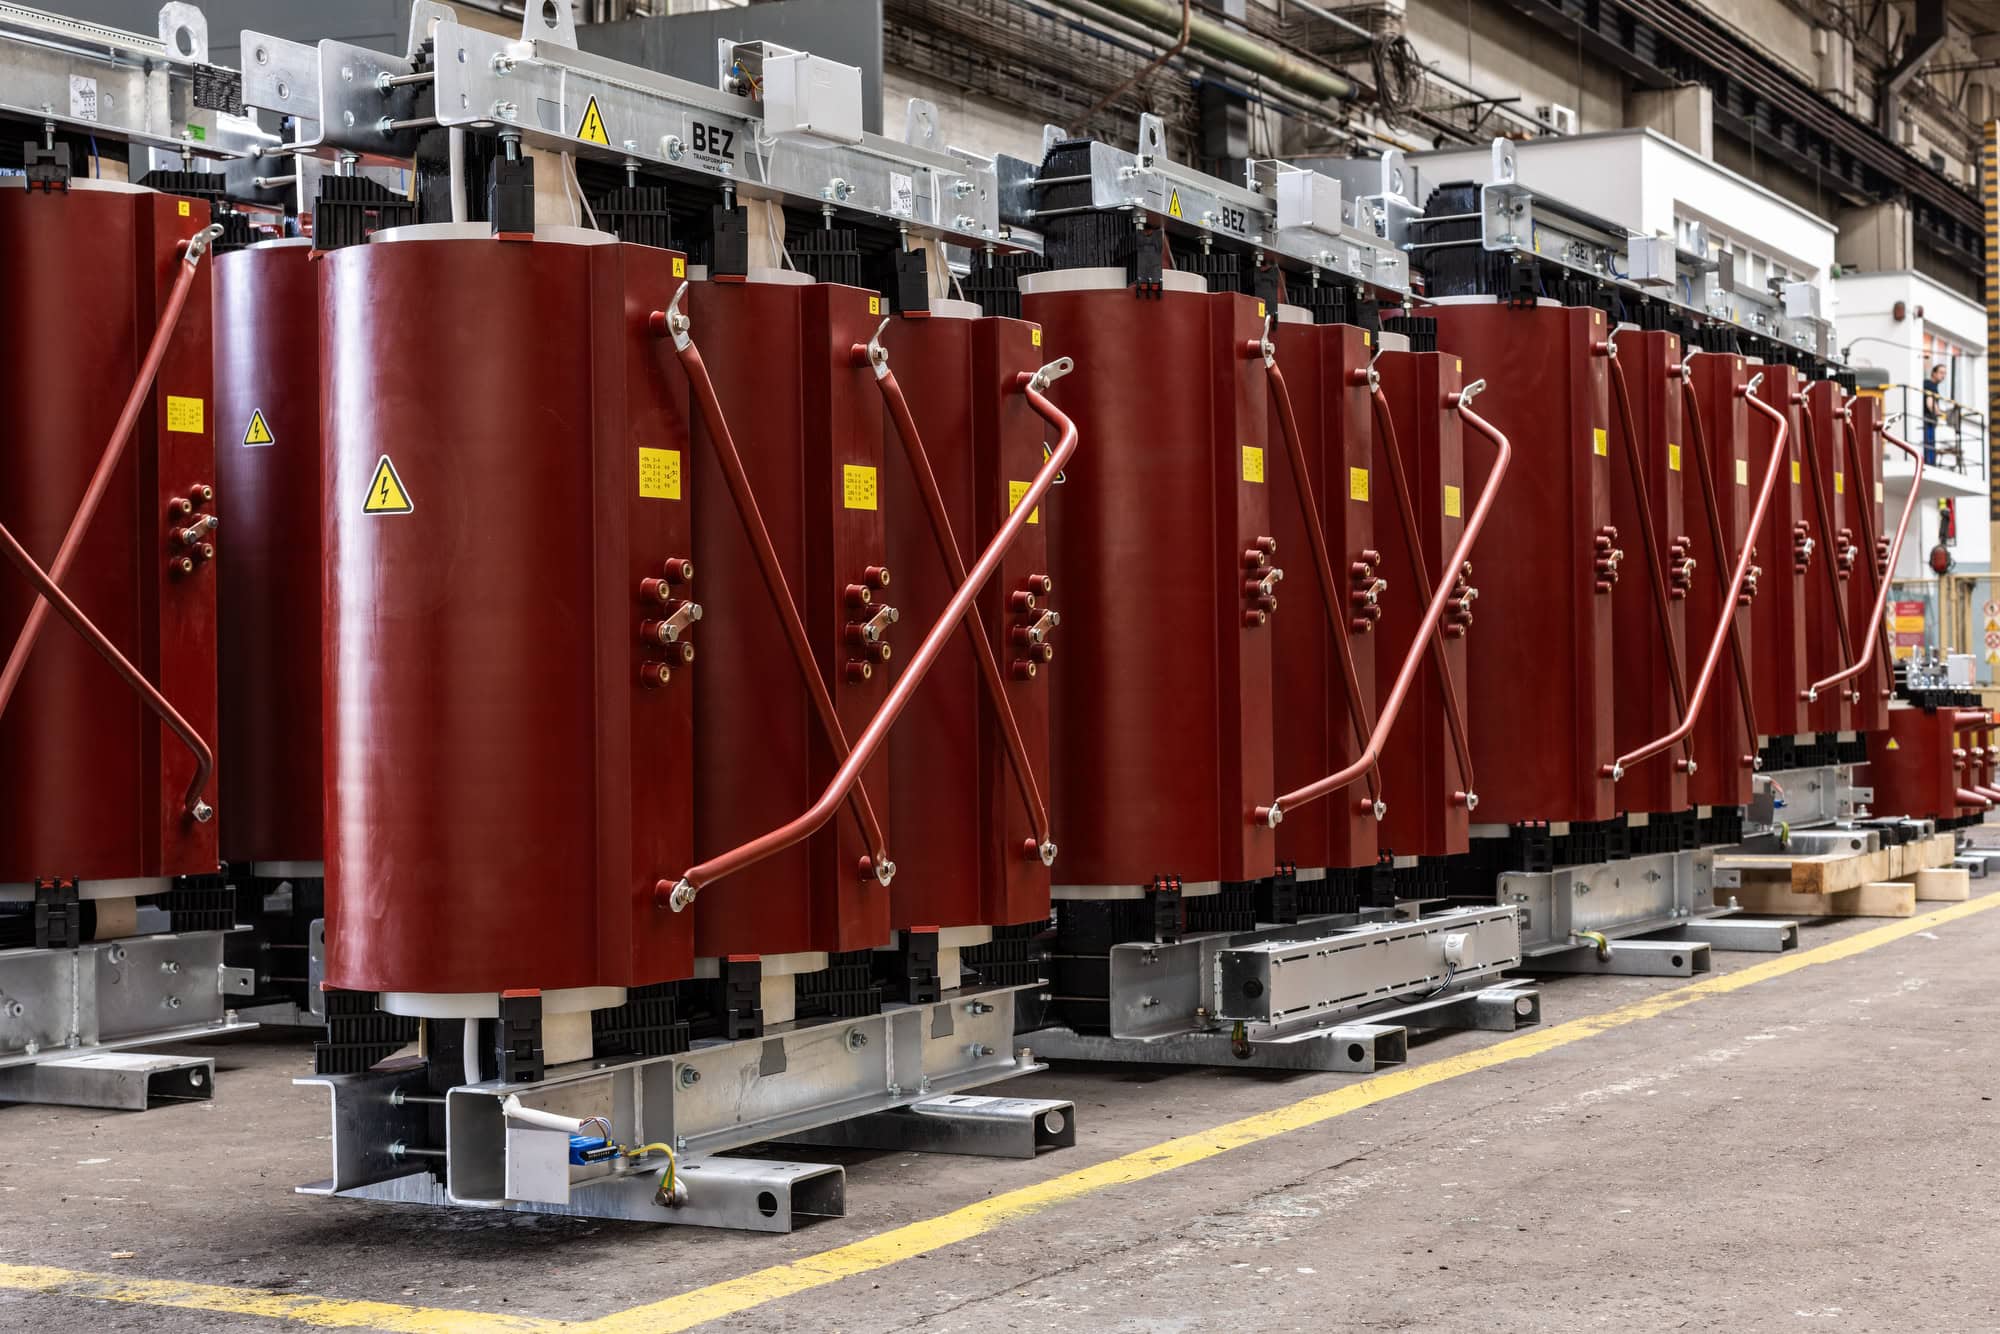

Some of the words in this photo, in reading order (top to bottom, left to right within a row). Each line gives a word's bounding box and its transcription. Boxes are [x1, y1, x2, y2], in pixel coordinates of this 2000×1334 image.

[692, 121, 734, 159] BEZ
[1222, 206, 1245, 233] BEZ
[675, 262, 682, 273] A
[871, 301, 876, 311] B
